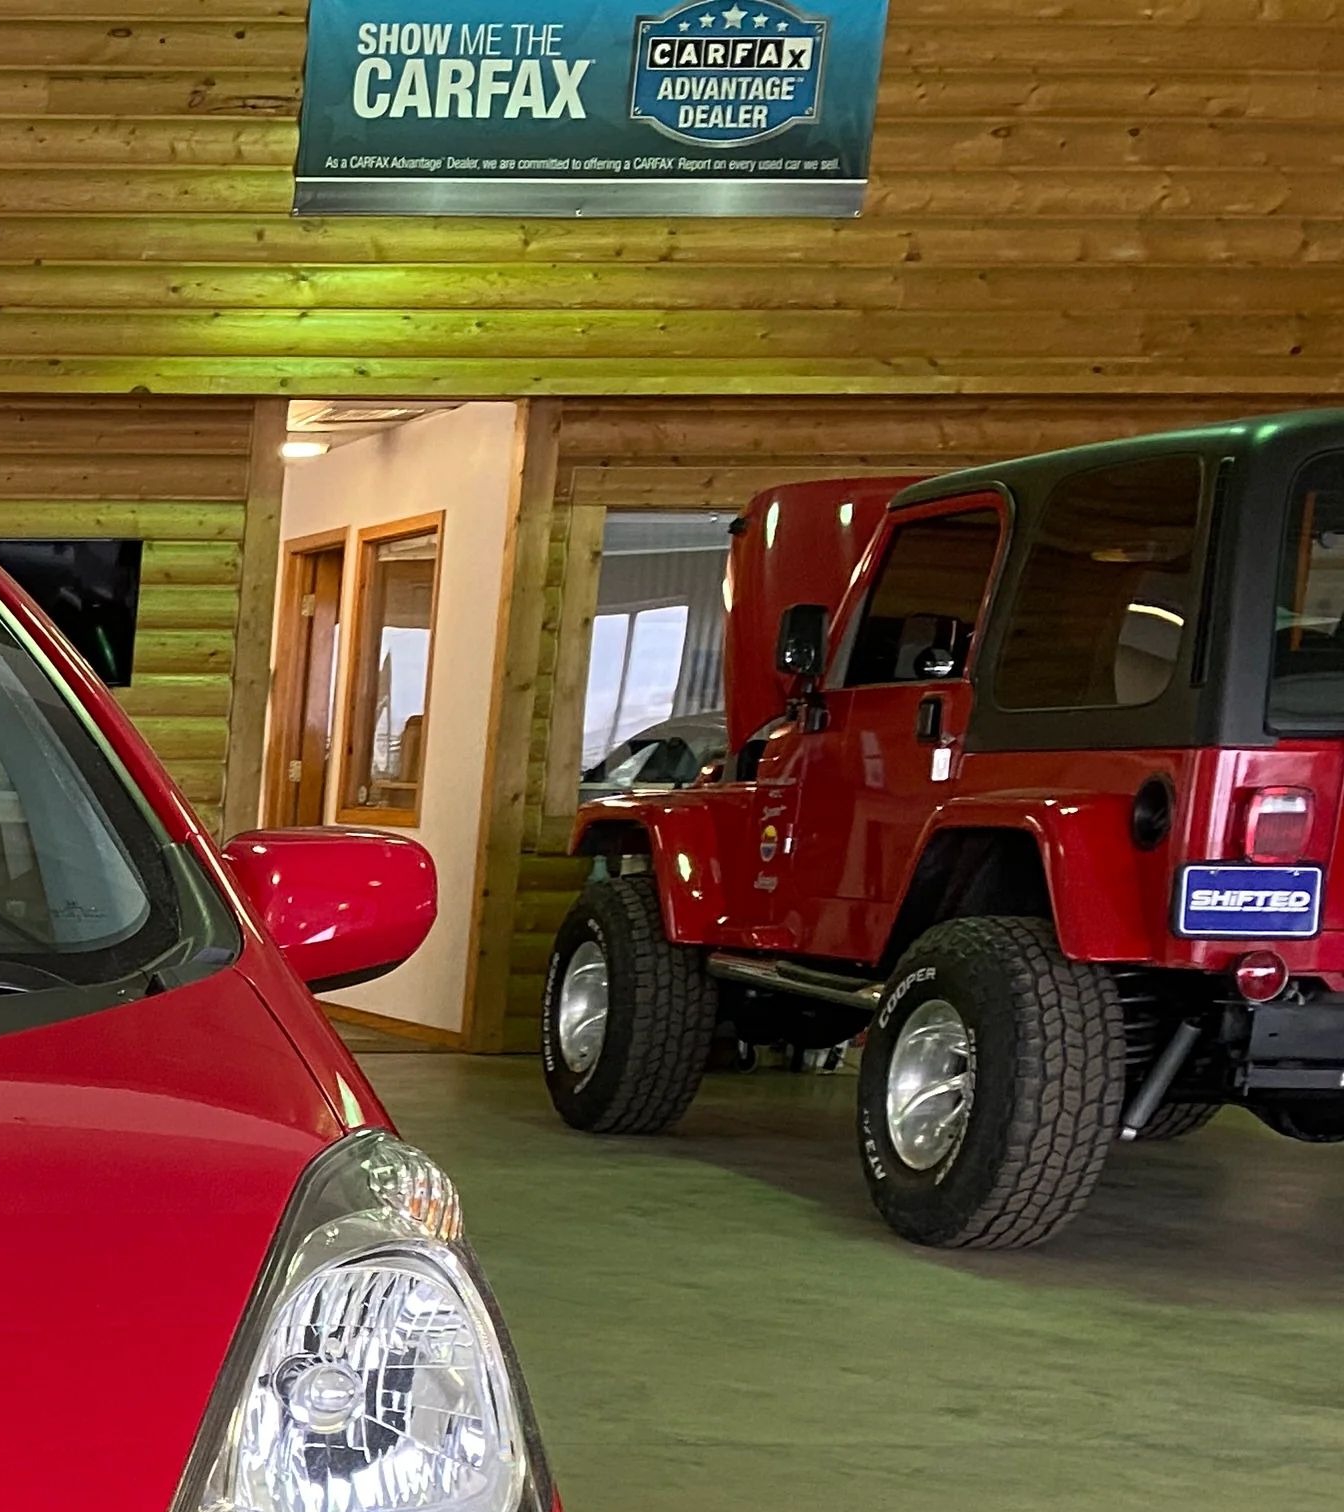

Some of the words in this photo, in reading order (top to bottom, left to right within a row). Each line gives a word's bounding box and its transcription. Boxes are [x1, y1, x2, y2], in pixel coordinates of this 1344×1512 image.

[357, 22, 453, 55] SHOW
[459, 23, 504, 55] ME
[510, 24, 564, 56] THE
[653, 42, 806, 69] CARFAX
[353, 57, 591, 119] CARFAX
[657, 77, 796, 100] ADVANTAGE
[678, 105, 769, 128] DEALER
[325, 156, 339, 169] As
[340, 158, 348, 169] a
[349, 156, 390, 169] CARFAX
[482, 159, 497, 169] we
[499, 159, 516, 169] are
[518, 158, 570, 170] committed
[571, 159, 582, 170] to
[583, 157, 622, 172] offering
[623, 159, 631, 170] a
[678, 158, 712, 171] Report
[713, 159, 727, 170] on
[728, 159, 757, 172] every
[758, 158, 784, 170] used
[784, 159, 802, 170] car
[803, 159, 819, 170] we
[879, 967, 936, 1029] COOPER
